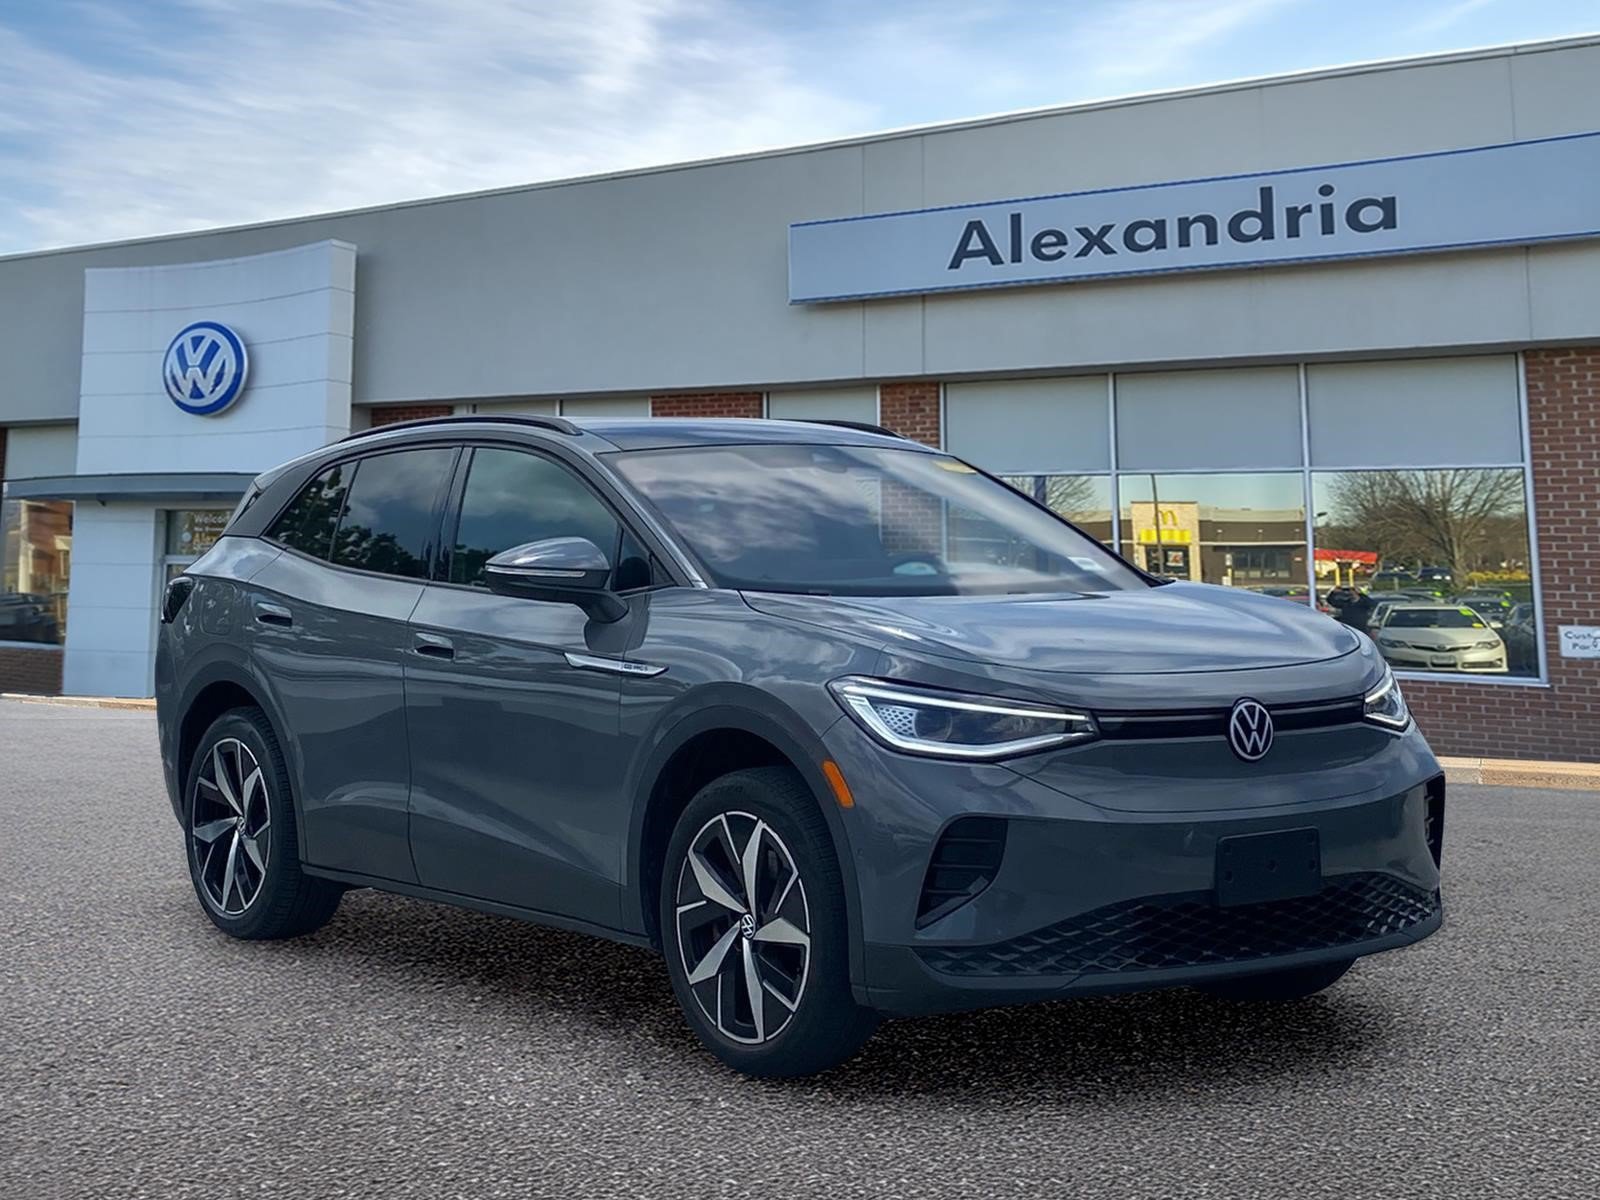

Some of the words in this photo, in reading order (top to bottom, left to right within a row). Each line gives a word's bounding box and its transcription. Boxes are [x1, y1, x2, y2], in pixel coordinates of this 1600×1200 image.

[947, 183, 1397, 270] Alexandria
[166, 329, 235, 406] VW
[1231, 703, 1272, 758] VW
